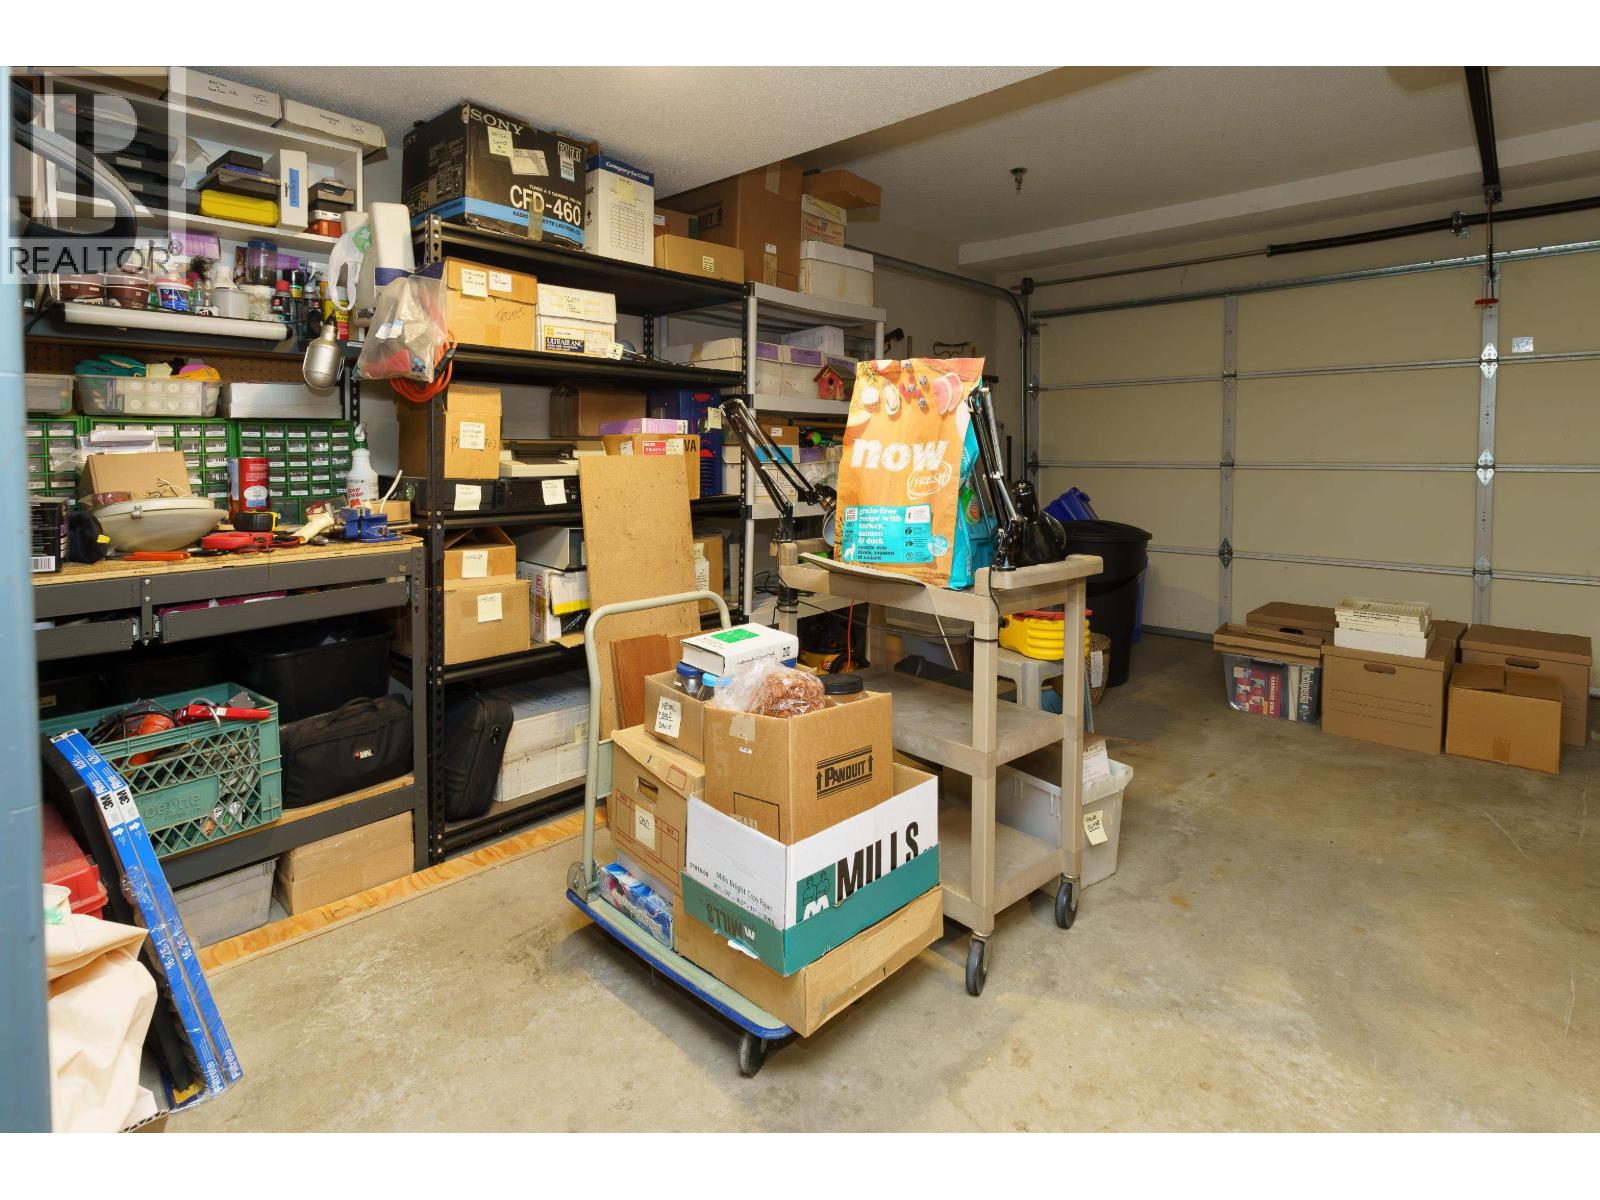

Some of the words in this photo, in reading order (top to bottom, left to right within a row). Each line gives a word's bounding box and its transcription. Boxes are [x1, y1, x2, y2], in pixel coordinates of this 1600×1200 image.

[470, 108, 524, 136] SONY
[510, 185, 581, 227] CFD-460
[851, 438, 950, 472] now
[825, 760, 866, 787] PANDUIT
[101, 794, 114, 810] 3M
[117, 790, 130, 806] 3M
[837, 821, 919, 903] MILLS
